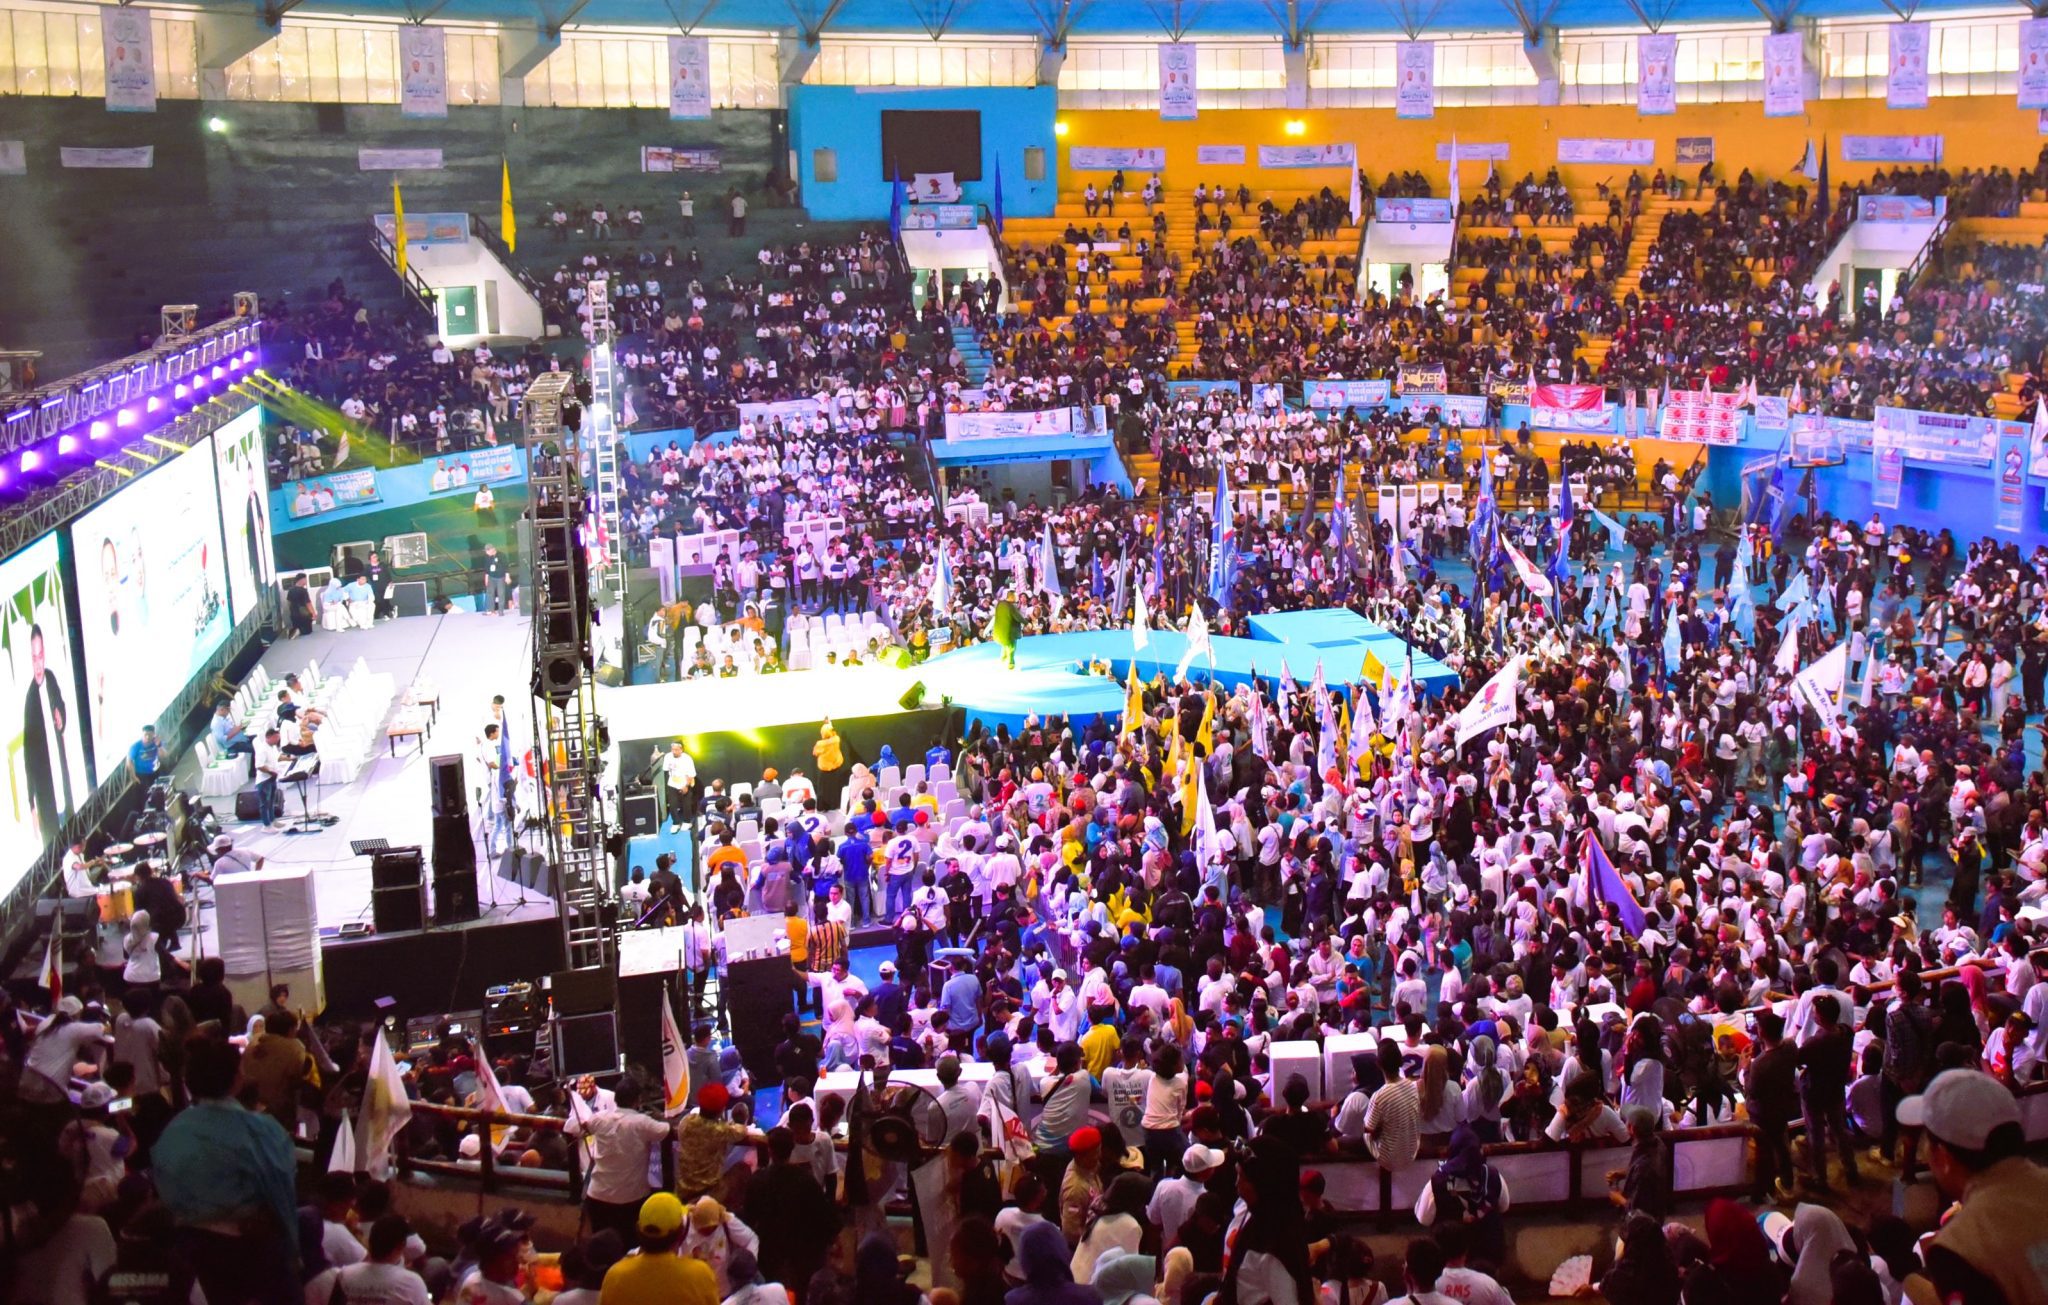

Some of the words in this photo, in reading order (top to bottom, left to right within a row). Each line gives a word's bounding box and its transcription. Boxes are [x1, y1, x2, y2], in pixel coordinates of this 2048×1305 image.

[958, 422, 981, 437] 02
[1036, 795, 1044, 806] 2
[804, 817, 820, 832] 2
[898, 840, 913, 860] 2
[1402, 1054, 1424, 1079] 2
[1126, 1110, 1136, 1125] 2
[1445, 1284, 1472, 1299] RMS
